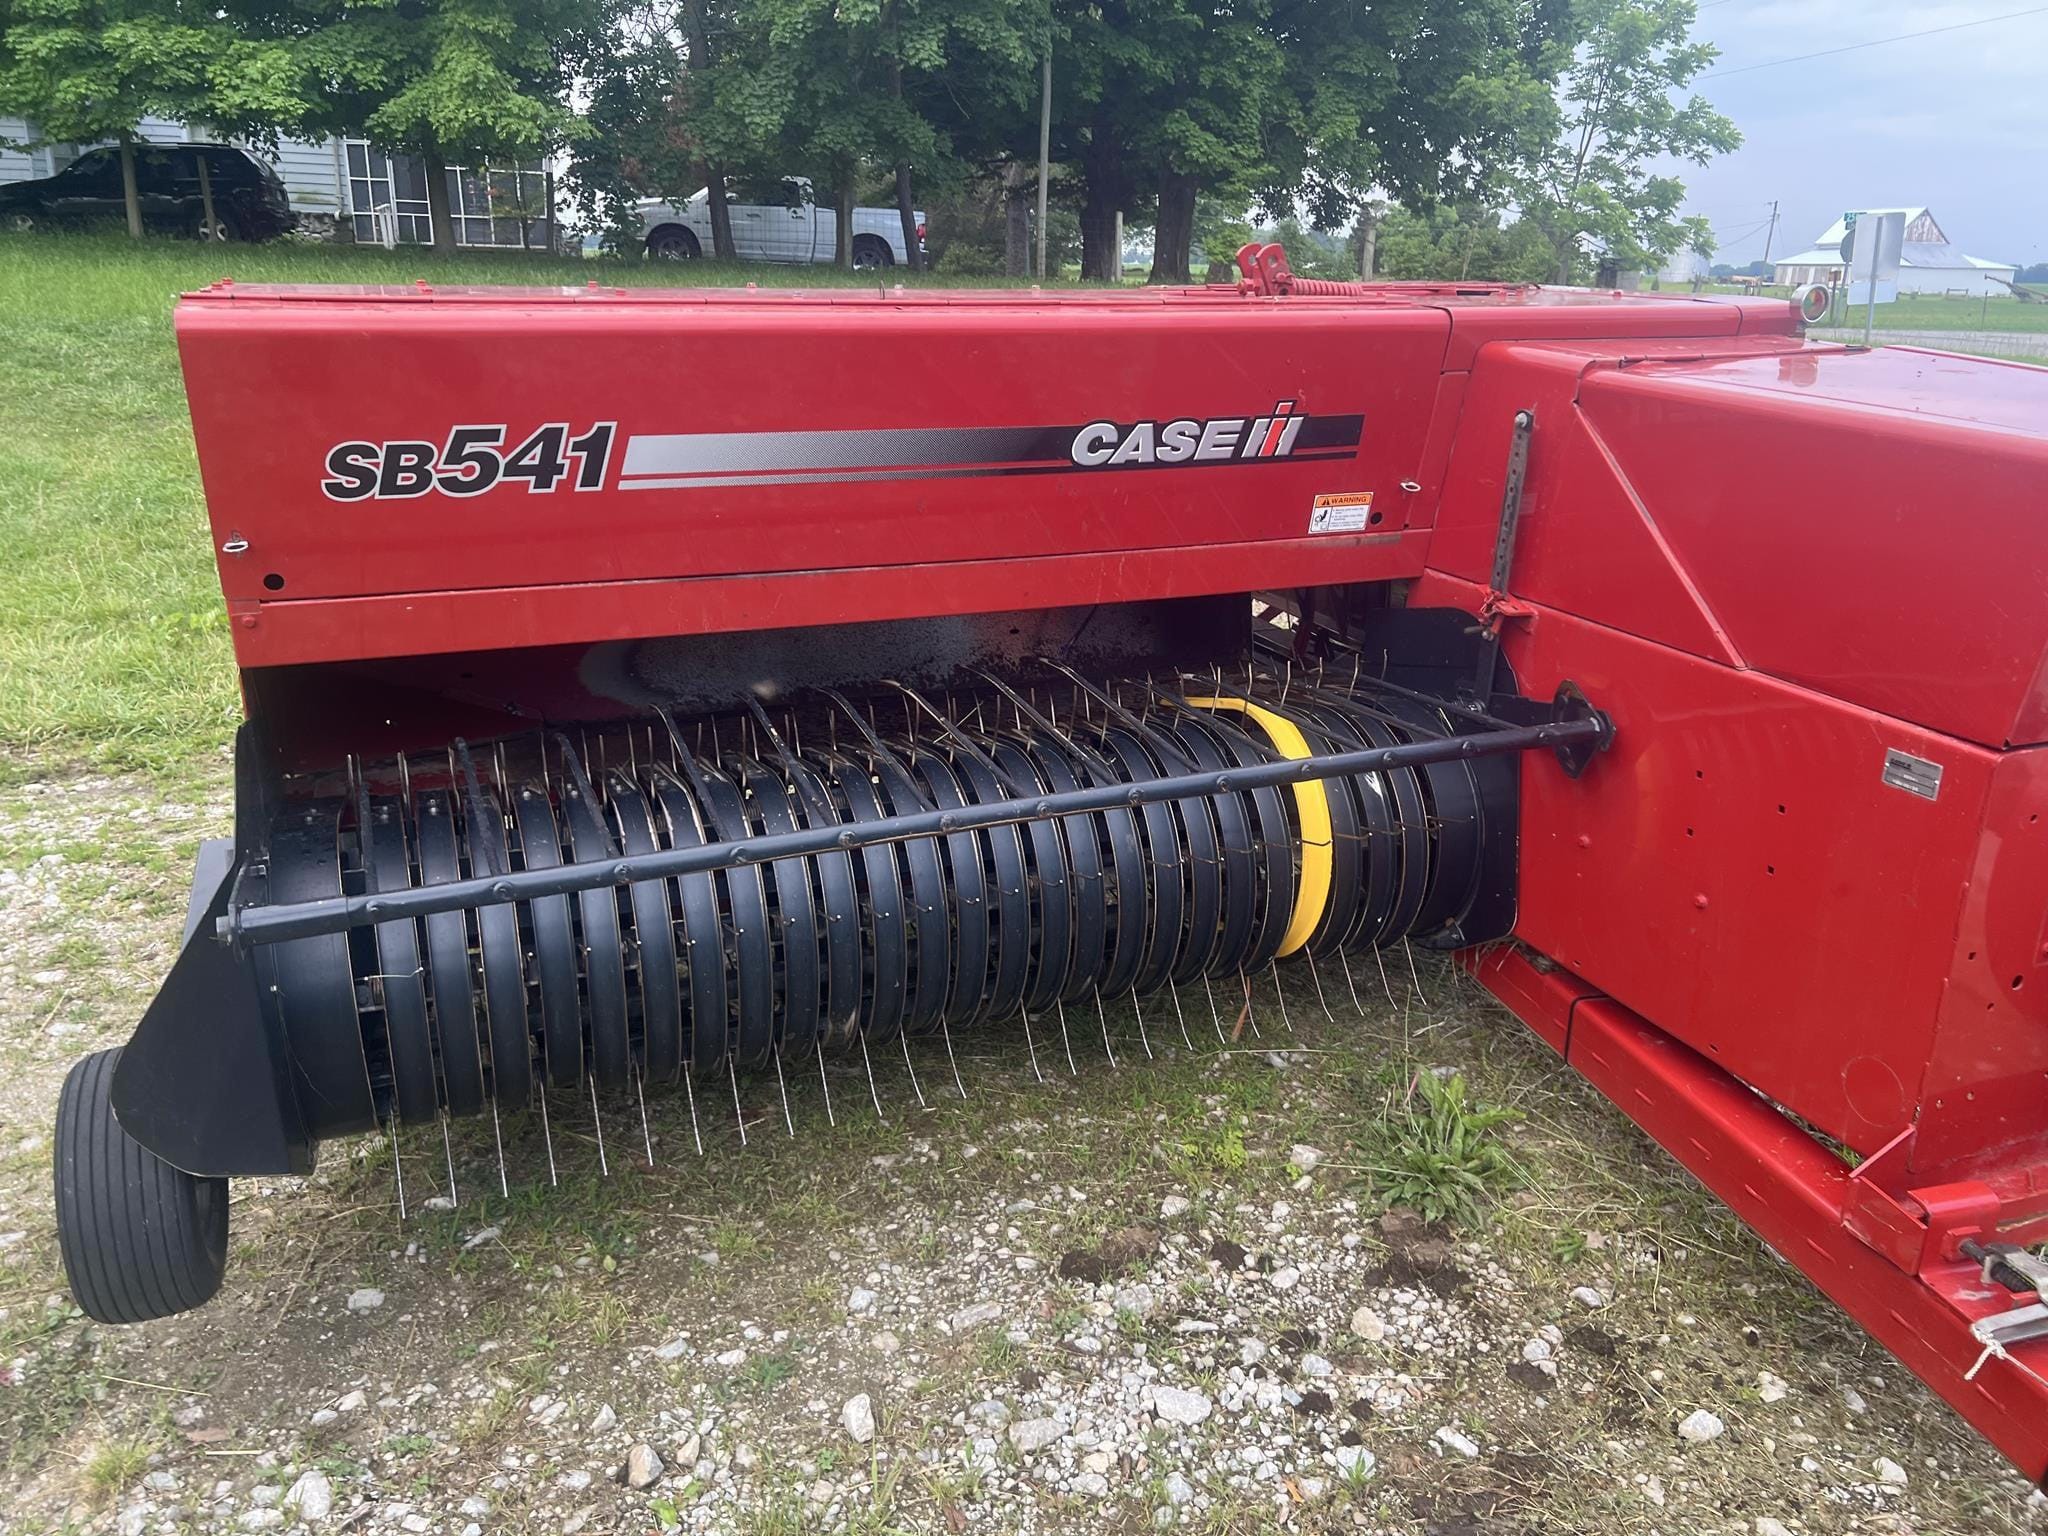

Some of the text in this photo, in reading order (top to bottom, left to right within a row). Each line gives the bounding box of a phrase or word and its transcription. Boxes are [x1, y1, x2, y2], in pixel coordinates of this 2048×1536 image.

[321, 421, 618, 502] SB541
[1071, 419, 1245, 466] CASE
[1331, 496, 1367, 504] WARNING
